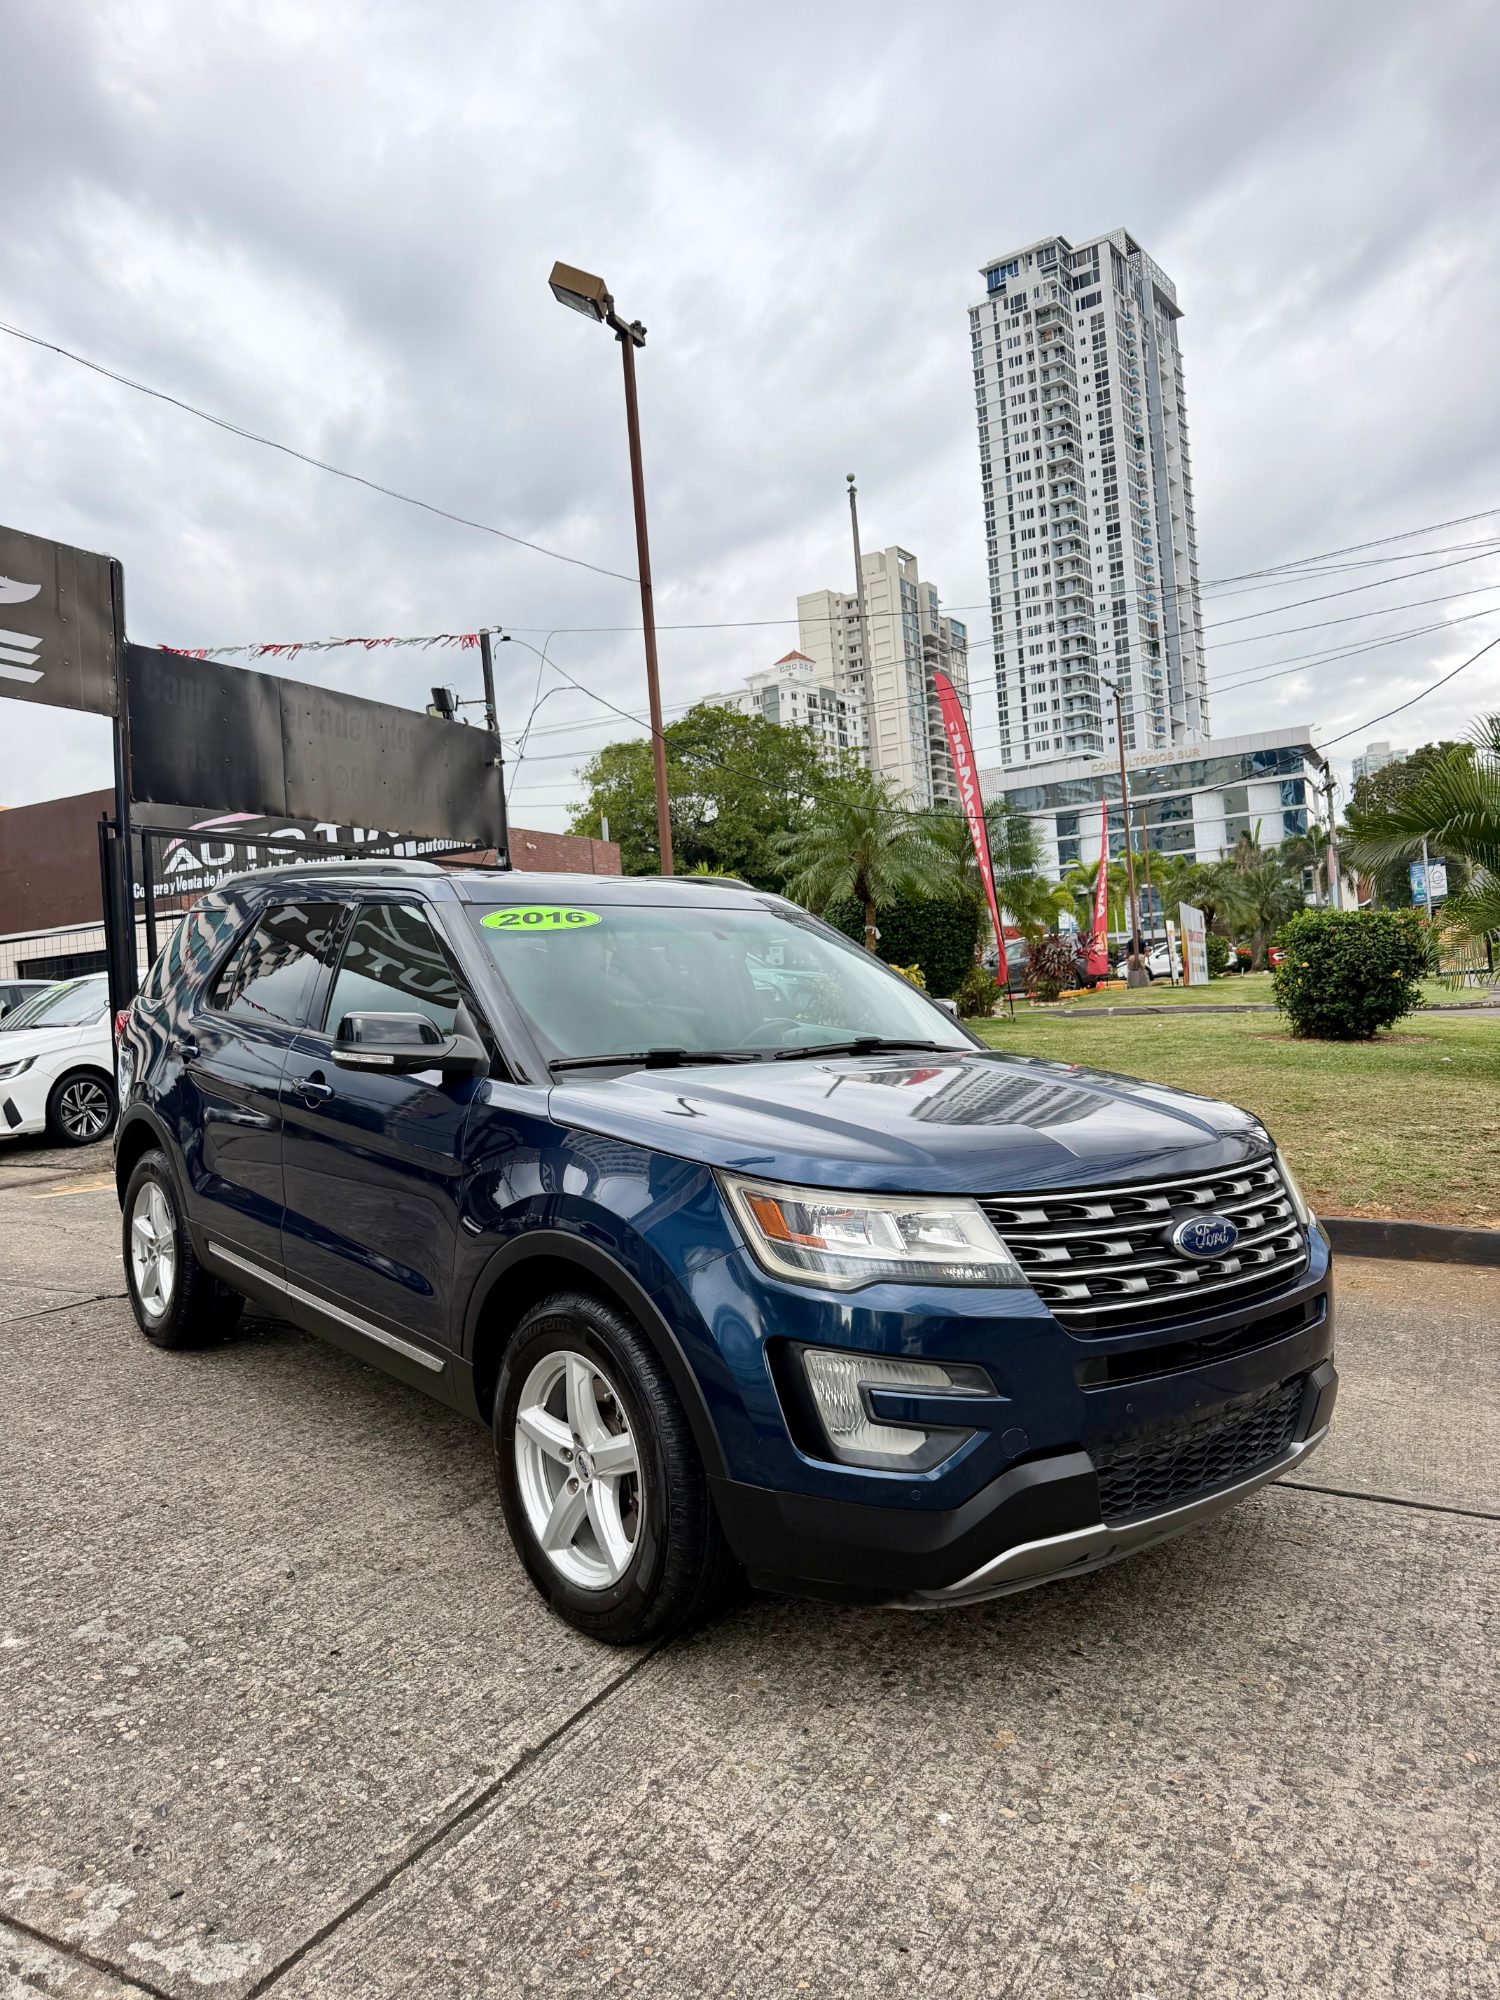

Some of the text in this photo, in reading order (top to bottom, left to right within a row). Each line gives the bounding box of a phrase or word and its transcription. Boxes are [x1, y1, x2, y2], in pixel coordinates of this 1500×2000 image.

[1177, 748, 1201, 760] SUR
[133, 882, 168, 899] Copra
[176, 875, 203, 892] Venta
[498, 911, 587, 927] 2016
[1195, 1222, 1232, 1249] Ford
